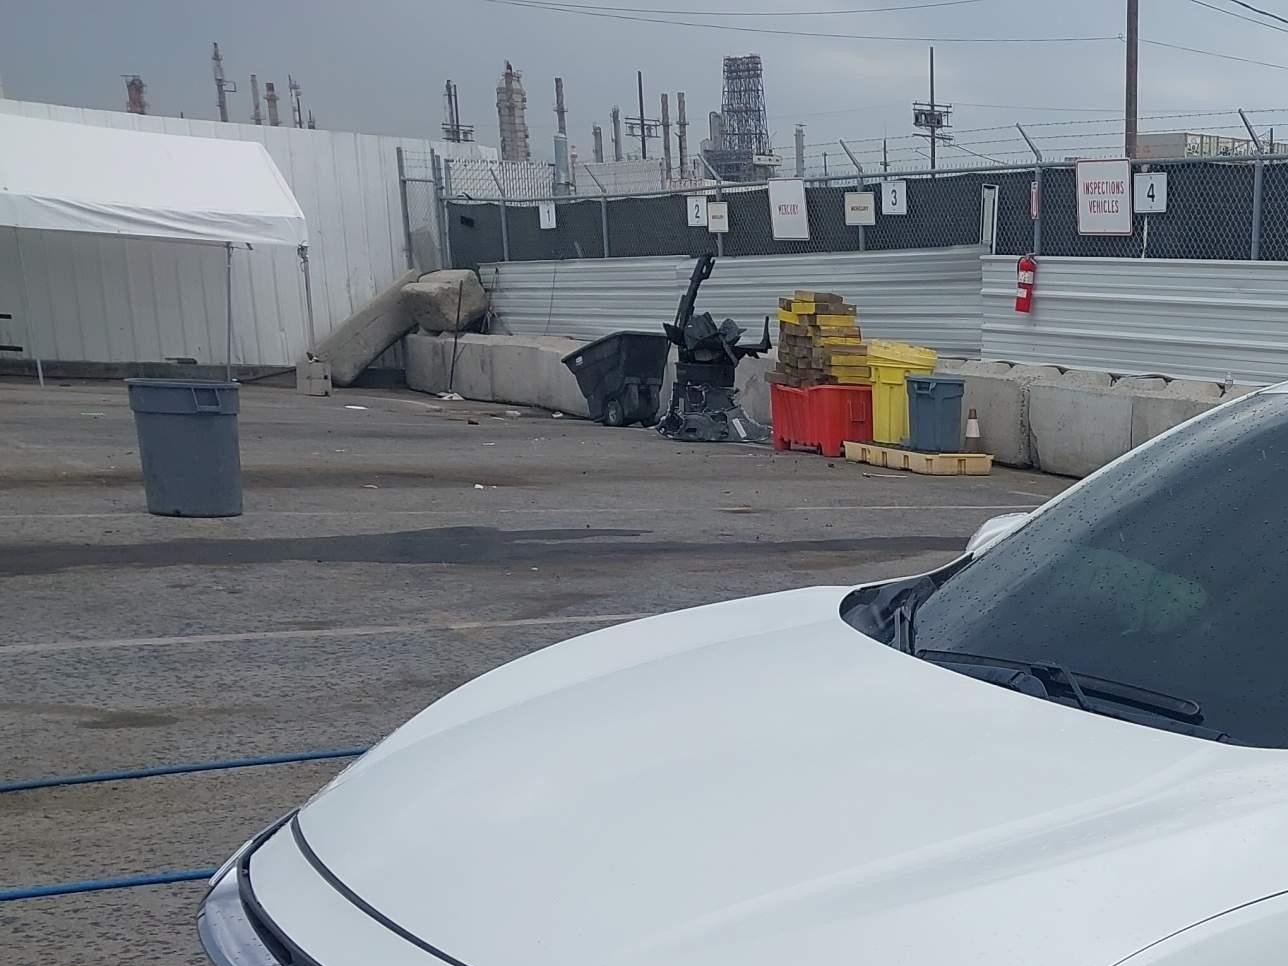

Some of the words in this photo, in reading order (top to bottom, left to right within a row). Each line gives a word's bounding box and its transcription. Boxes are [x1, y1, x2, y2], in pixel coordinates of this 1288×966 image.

[1083, 180, 1125, 195] INSPECTIONS
[1146, 183, 1156, 203] 4
[890, 189, 898, 207] 3
[694, 204, 701, 219] 2
[1088, 200, 1119, 214] VEHICLES
